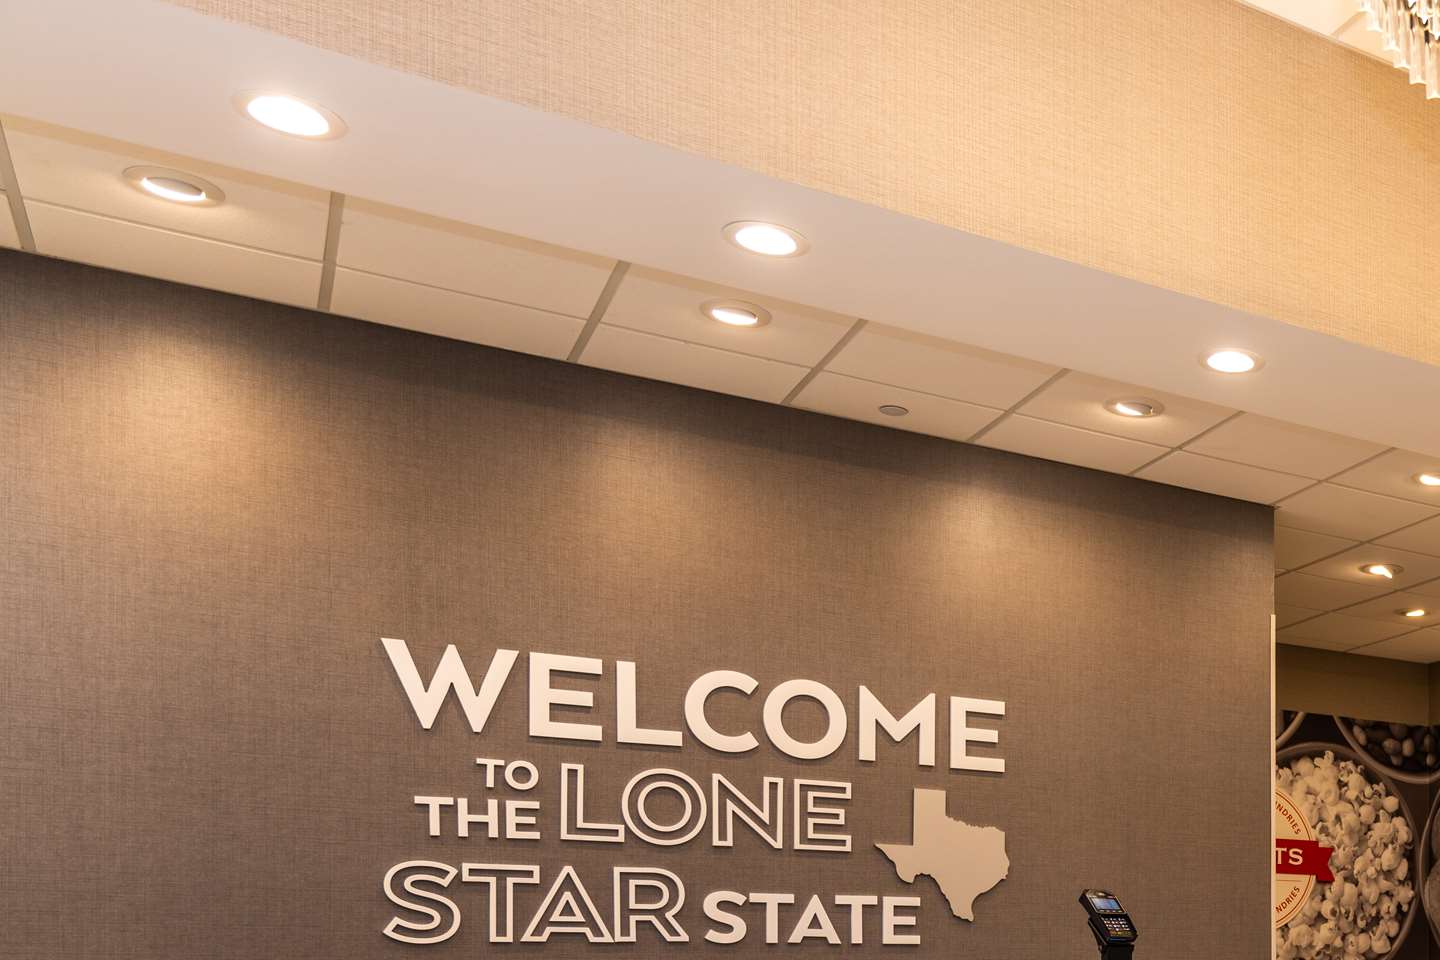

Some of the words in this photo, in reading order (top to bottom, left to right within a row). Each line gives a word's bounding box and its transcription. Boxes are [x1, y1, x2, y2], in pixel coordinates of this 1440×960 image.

[381, 637, 1006, 773] WELCOME
[476, 757, 540, 791] TO
[414, 795, 541, 841] THE
[560, 762, 852, 853] LONE
[1276, 802, 1302, 835] NDRIES
[382, 859, 690, 945] STAR
[703, 890, 921, 946] STATE
[1275, 885, 1301, 914] NDRIES
